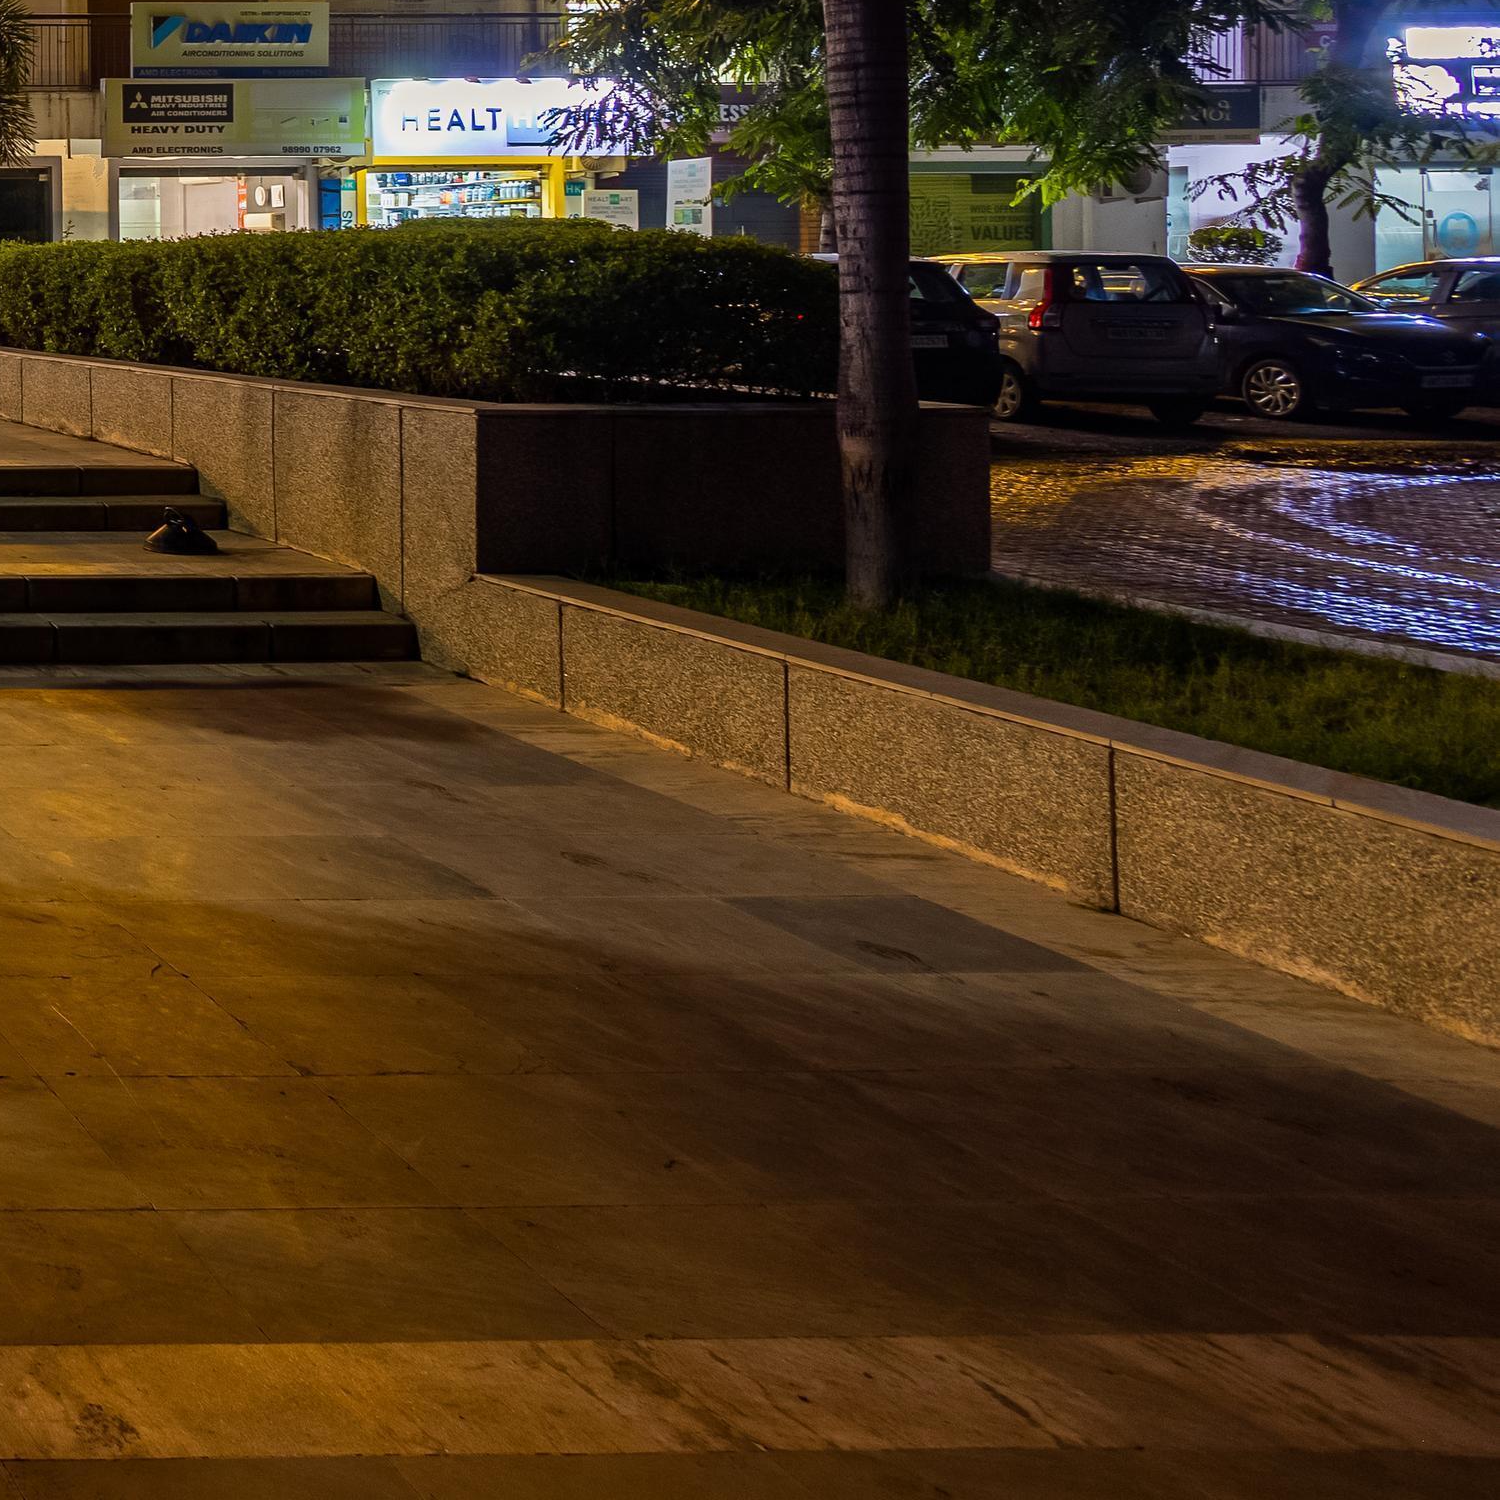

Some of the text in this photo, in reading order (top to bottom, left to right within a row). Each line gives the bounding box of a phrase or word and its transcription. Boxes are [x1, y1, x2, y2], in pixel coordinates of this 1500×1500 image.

[184, 22, 313, 45] DAIKIN
[181, 49, 304, 59] AIRCONDITIONING SOLUTIONS
[150, 94, 228, 104] MITSUBISHI
[130, 124, 226, 134] HEAVY DUTY
[131, 146, 342, 154] AMD ELECTRONICS 98990 07962
[970, 224, 1033, 241] VALUES
